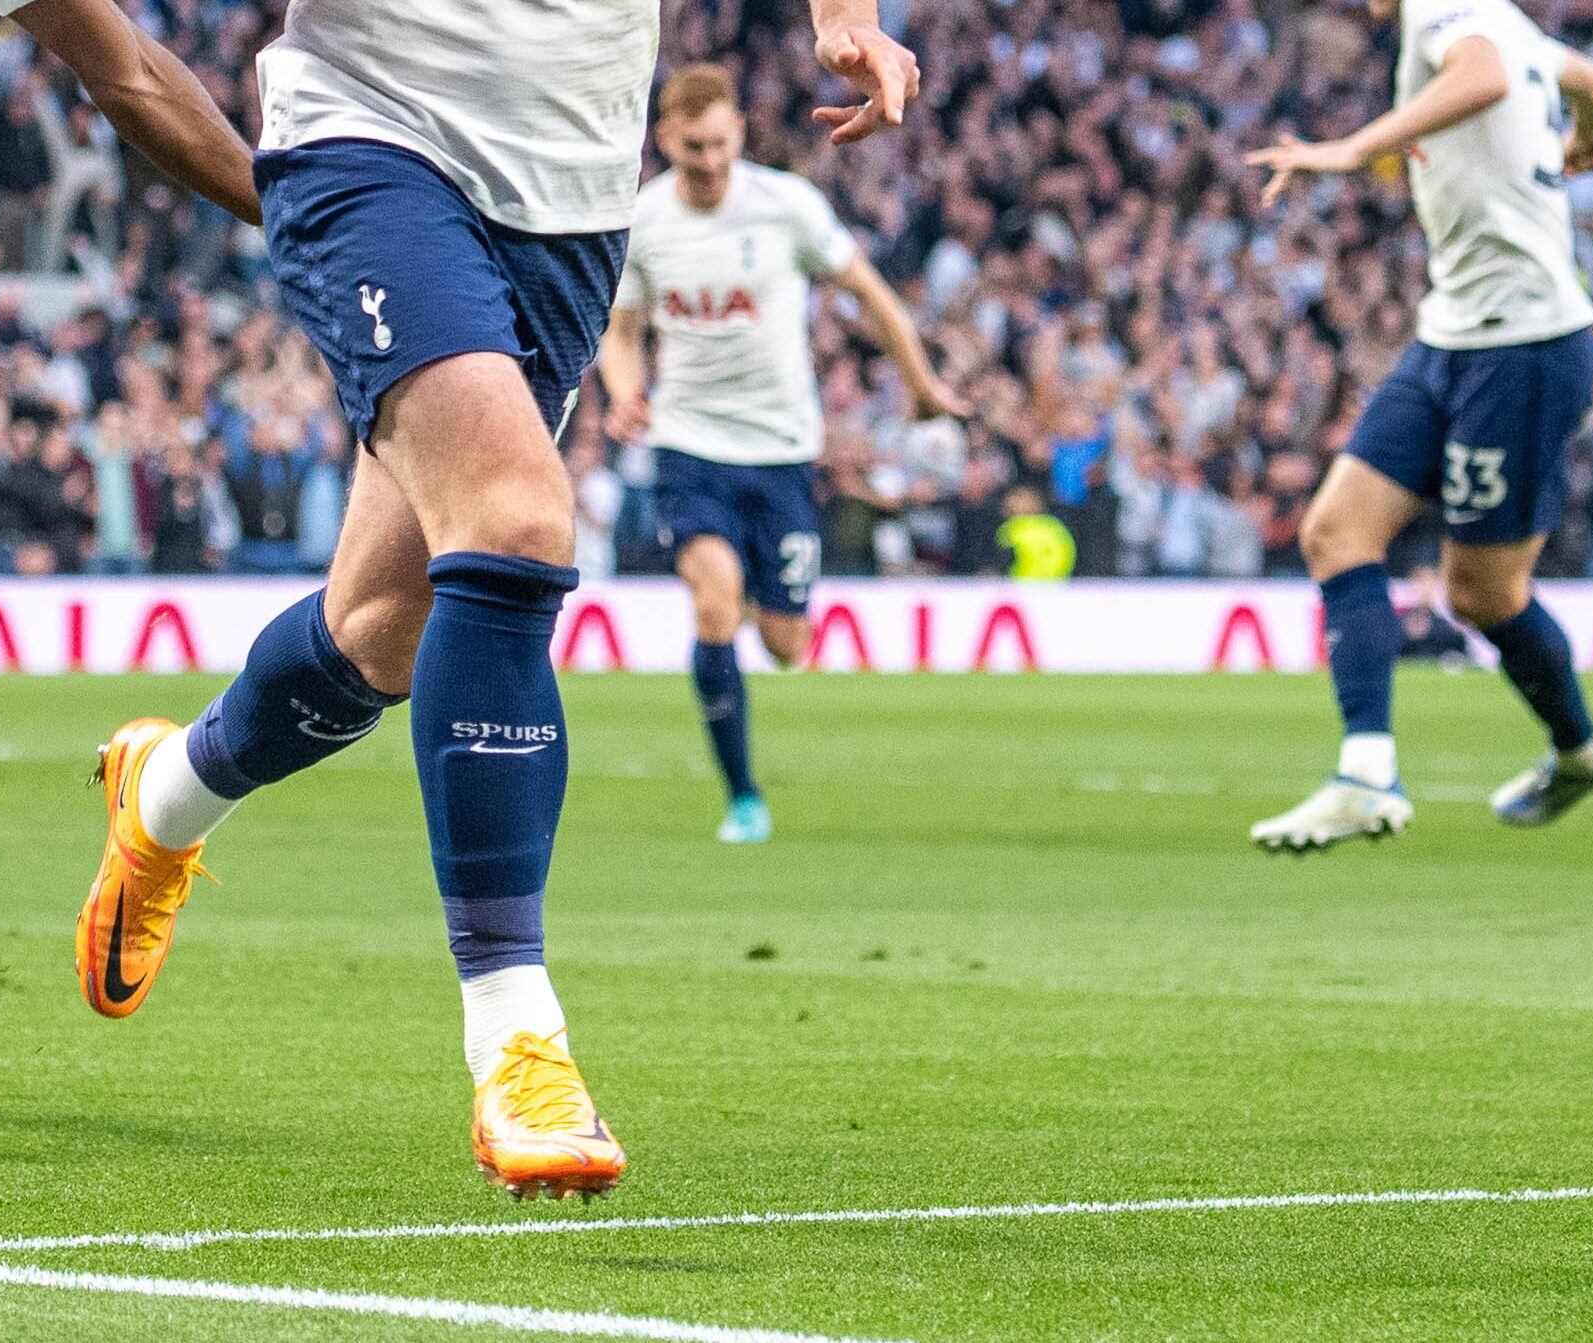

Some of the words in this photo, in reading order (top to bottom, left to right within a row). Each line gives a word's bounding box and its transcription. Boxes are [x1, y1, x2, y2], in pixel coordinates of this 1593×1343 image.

[661, 288, 761, 320] AIA
[1442, 442, 1508, 510] 33
[803, 599, 1041, 669] AIA
[451, 721, 558, 742] SPURS
